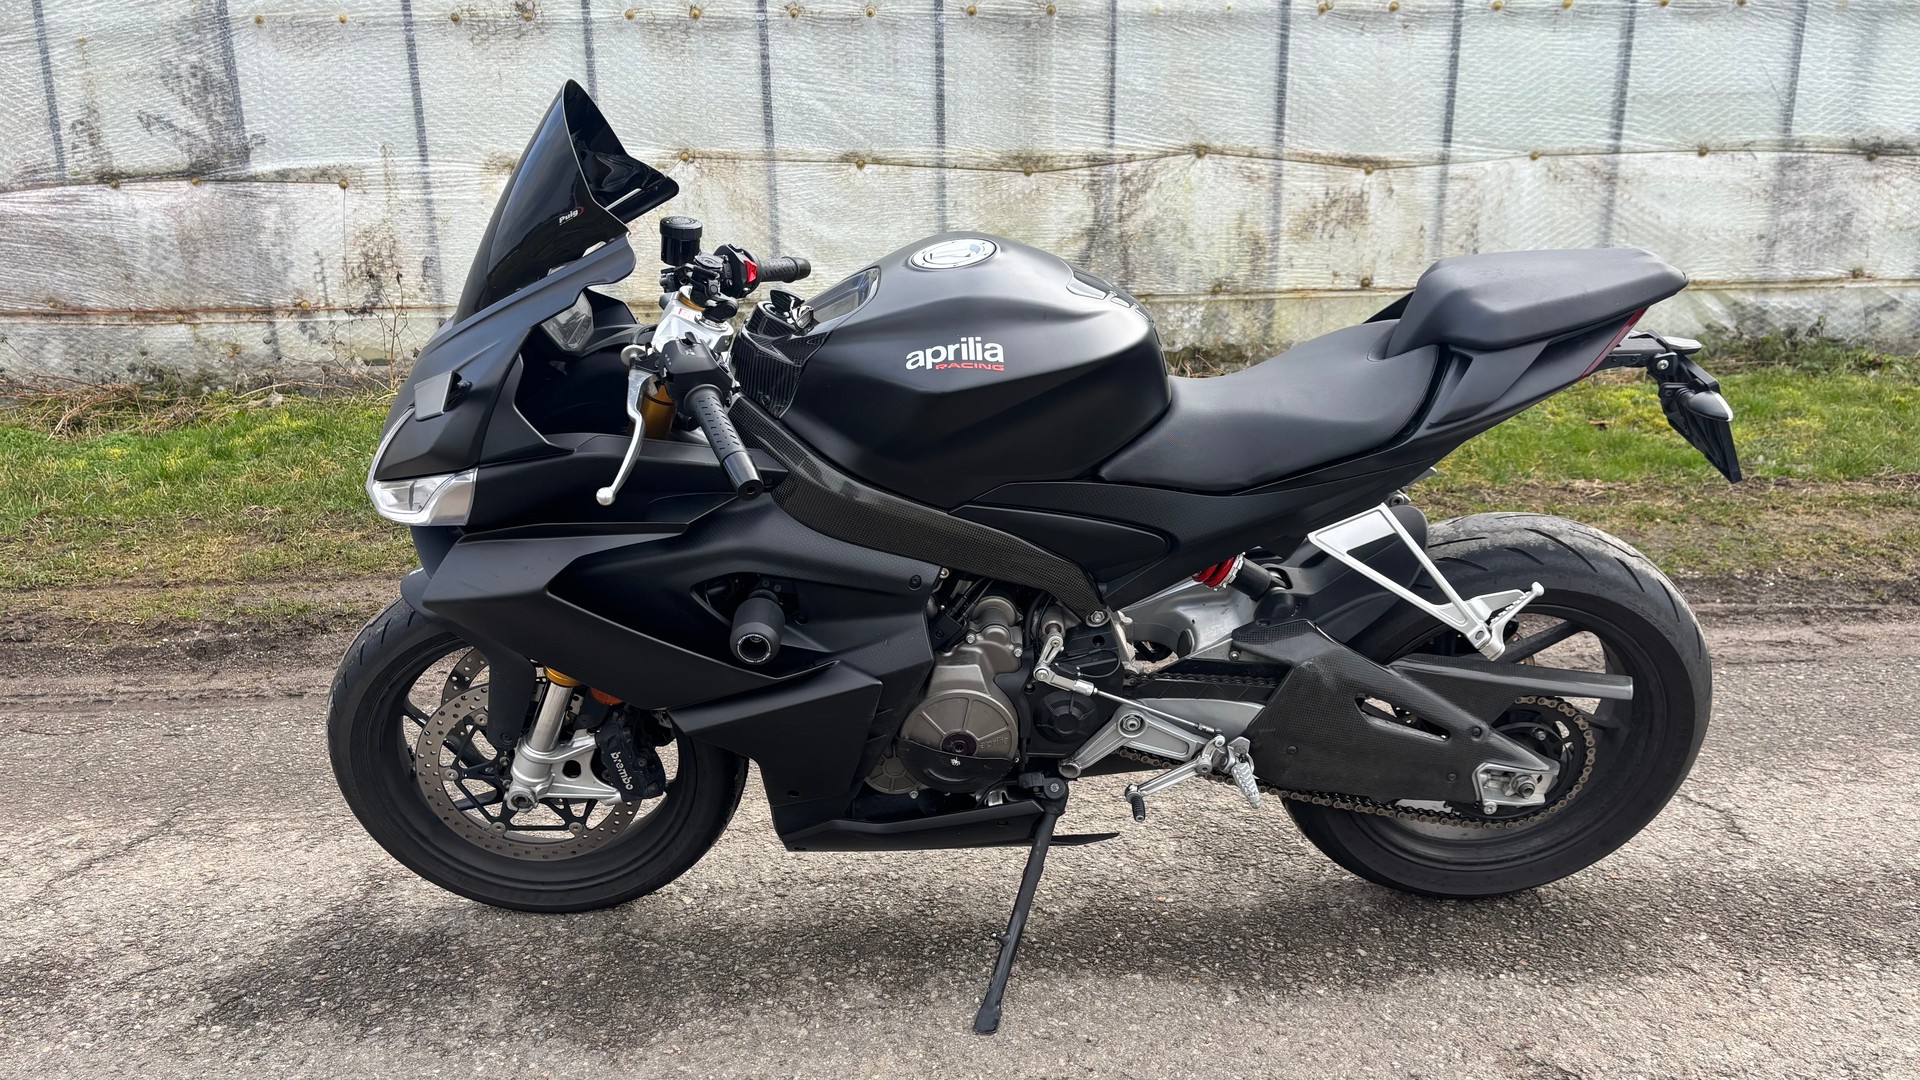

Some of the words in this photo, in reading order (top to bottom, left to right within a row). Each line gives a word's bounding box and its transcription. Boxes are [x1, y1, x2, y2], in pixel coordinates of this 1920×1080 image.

[559, 209, 579, 224] Puig
[905, 336, 1005, 370] aprilia
[935, 362, 1005, 371] RACING
[610, 751, 634, 790] brembo
